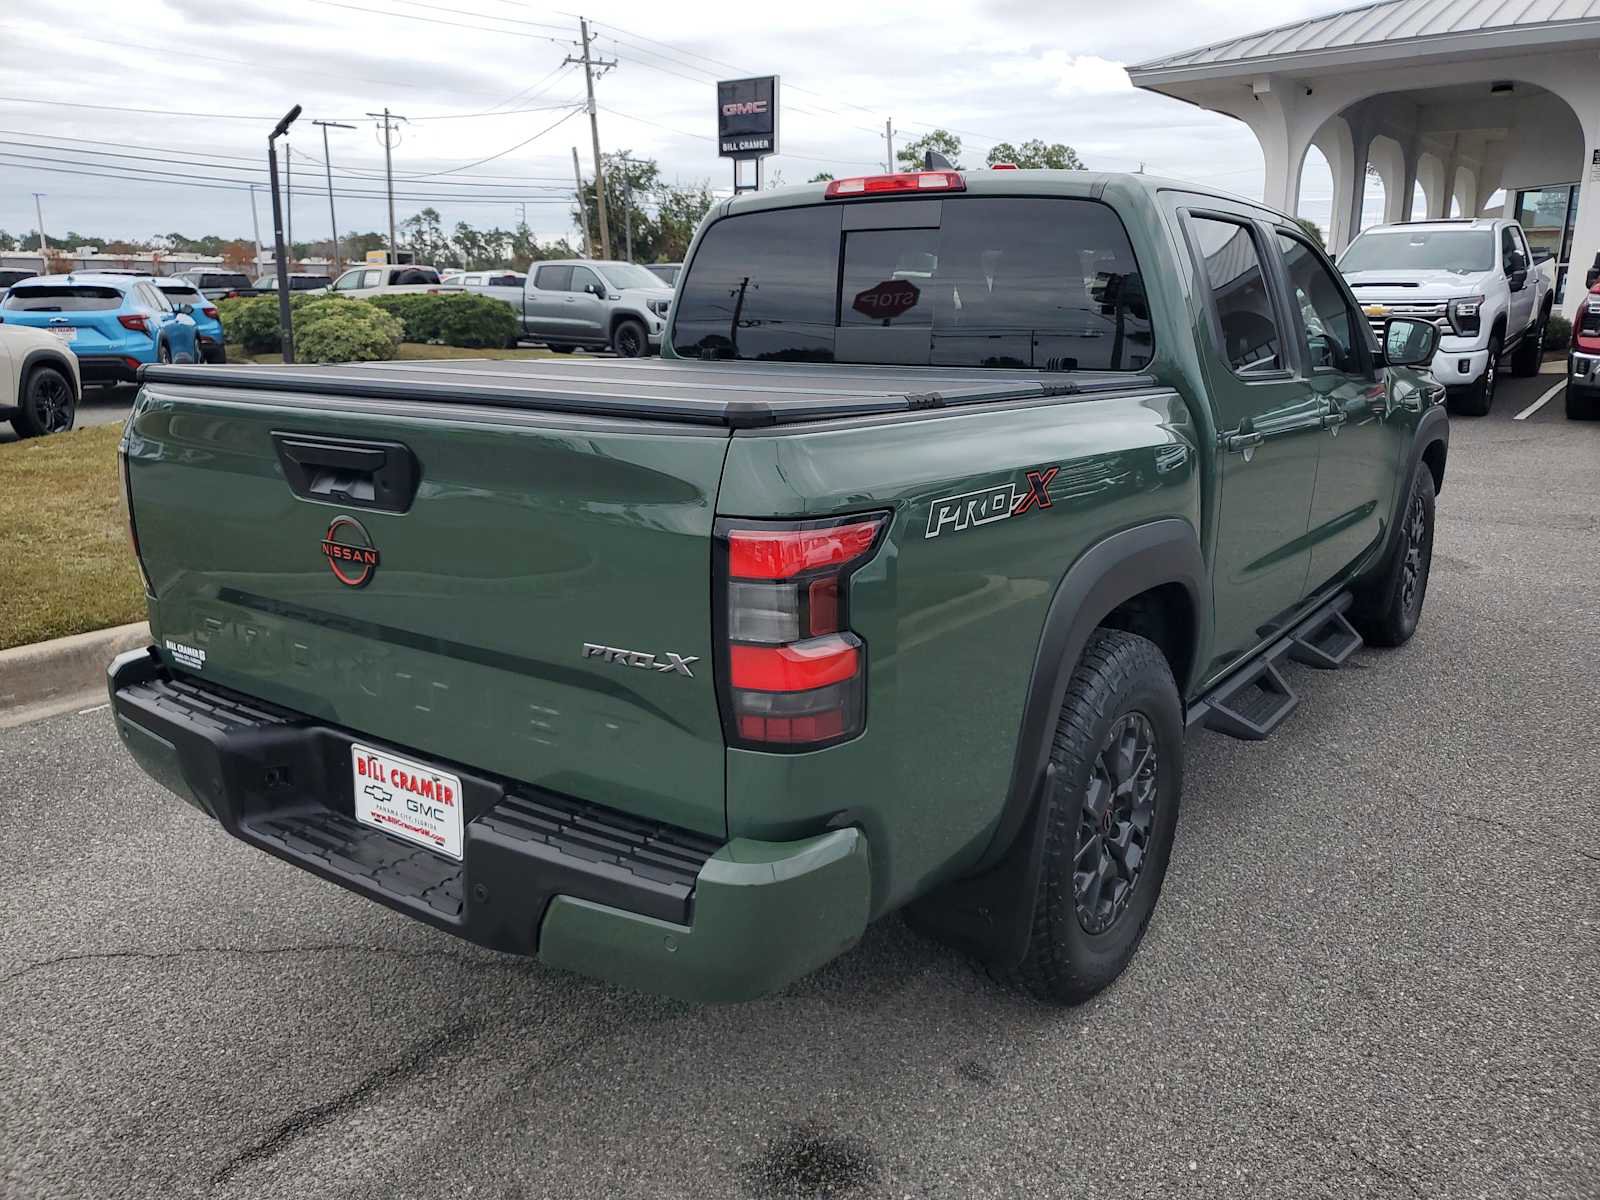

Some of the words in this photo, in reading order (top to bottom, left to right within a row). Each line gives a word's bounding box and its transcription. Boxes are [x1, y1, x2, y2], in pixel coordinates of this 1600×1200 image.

[722, 100, 768, 116] GMC
[722, 142, 738, 152] BILL
[739, 140, 769, 150] CRAMER
[322, 542, 376, 565] NISSAN
[357, 756, 387, 784] BILL
[390, 768, 455, 807] CRAMER
[376, 804, 399, 817] PANAMA
[414, 817, 437, 831] FLORIDA
[405, 798, 445, 823] GMC
